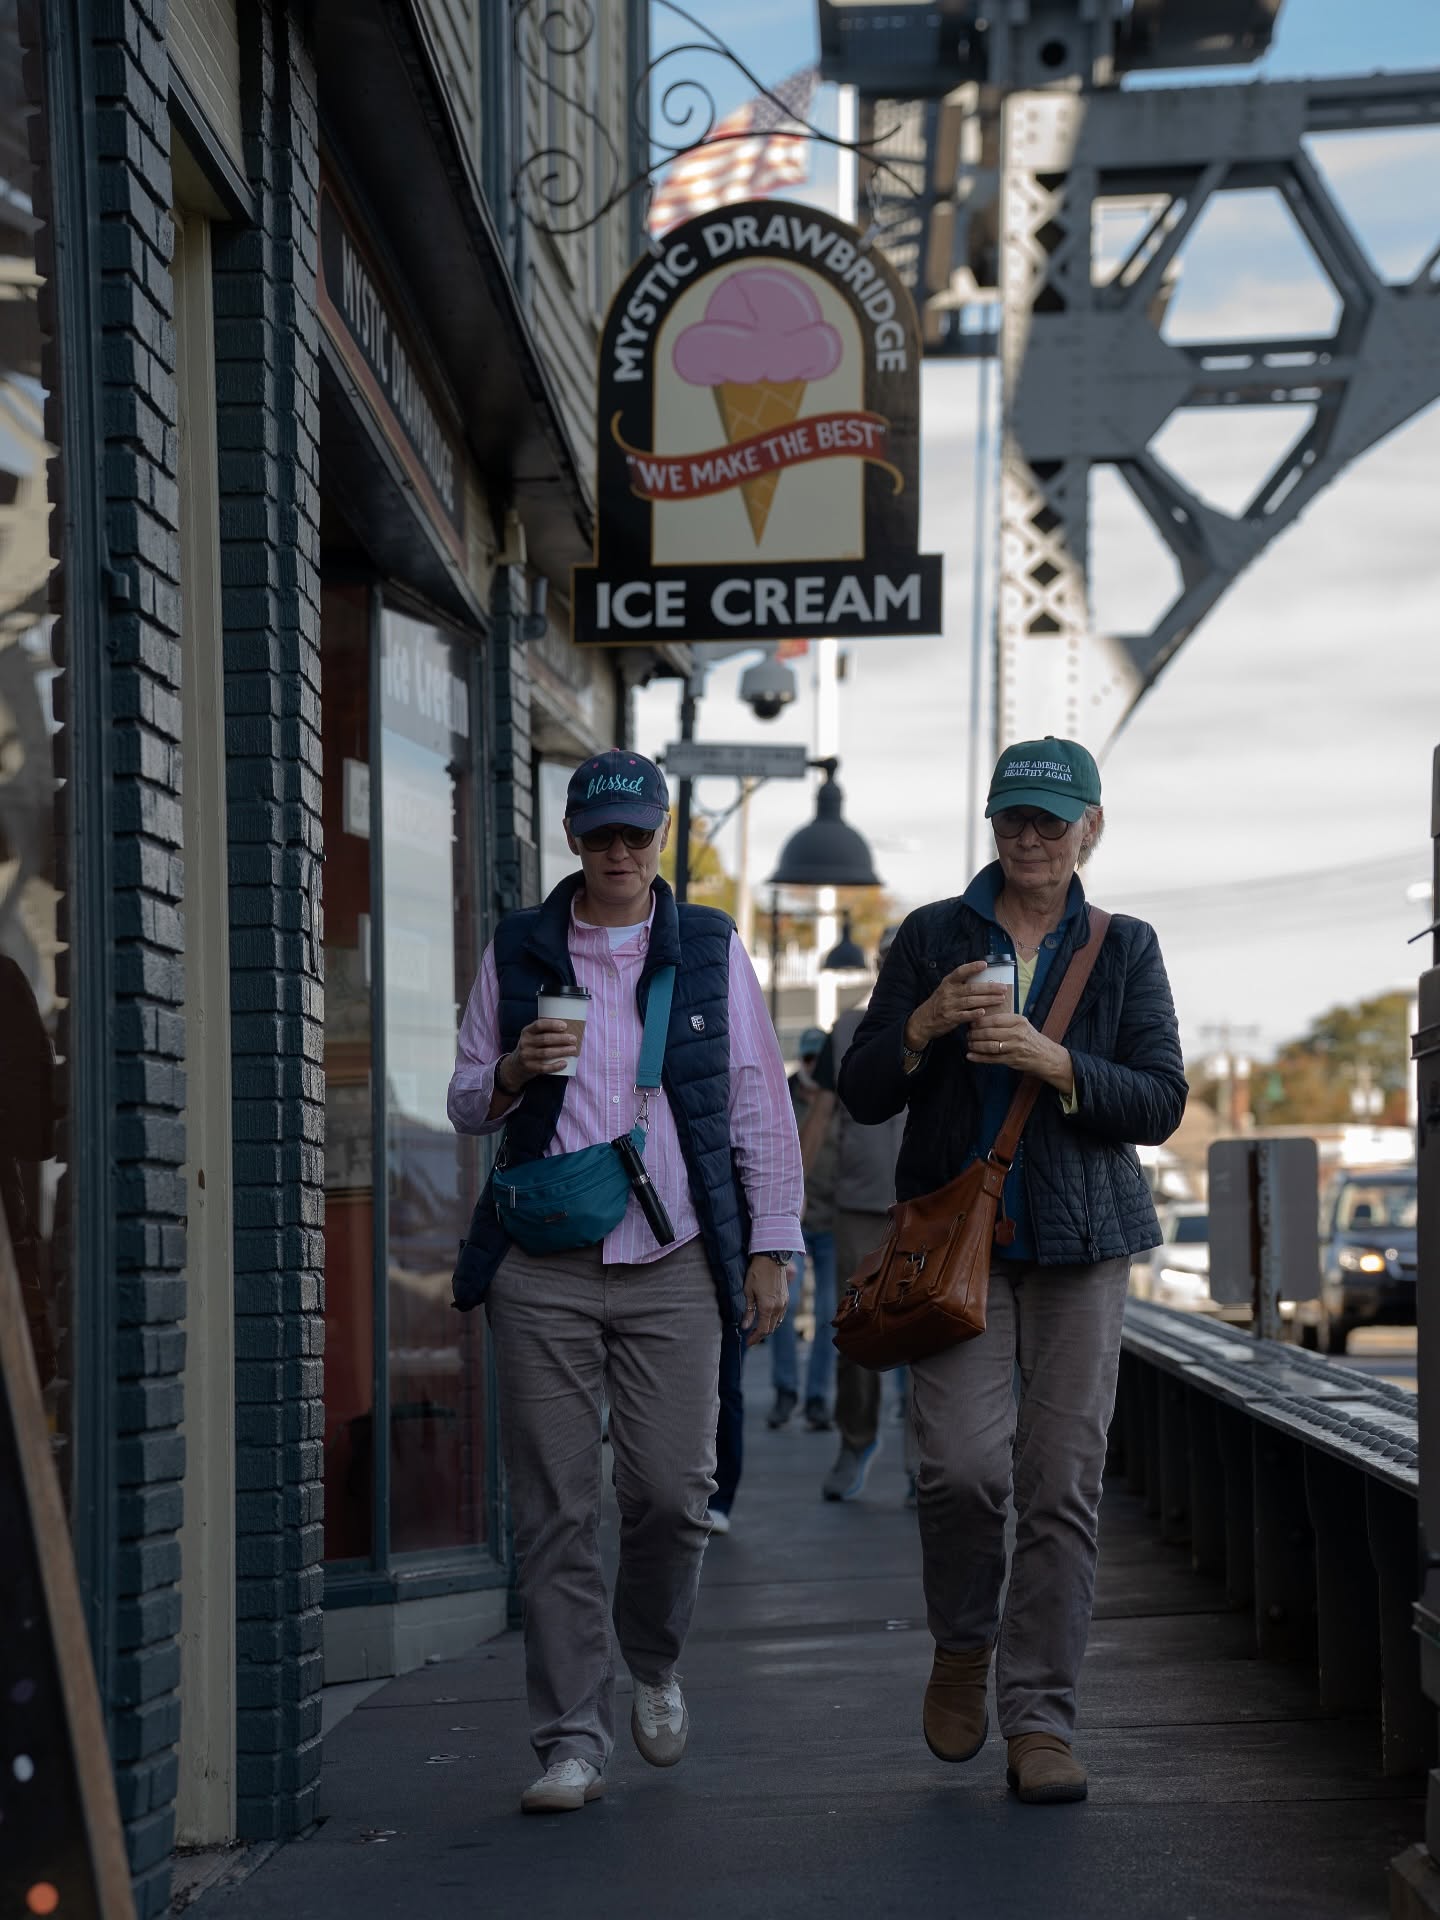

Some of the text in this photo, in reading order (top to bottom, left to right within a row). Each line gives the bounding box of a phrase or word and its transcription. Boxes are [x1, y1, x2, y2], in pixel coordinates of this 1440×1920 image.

[342, 232, 388, 384] MYSTIC
[613, 214, 907, 382] MYSTIC DRAWBRIDGE
[626, 419, 886, 493] "WE MAKE THE BEST"
[596, 573, 922, 629] ICE CREAM
[1003, 768, 1072, 782] HEALTHY AGAIN
[1008, 760, 1071, 773] MAKE AMERICA
